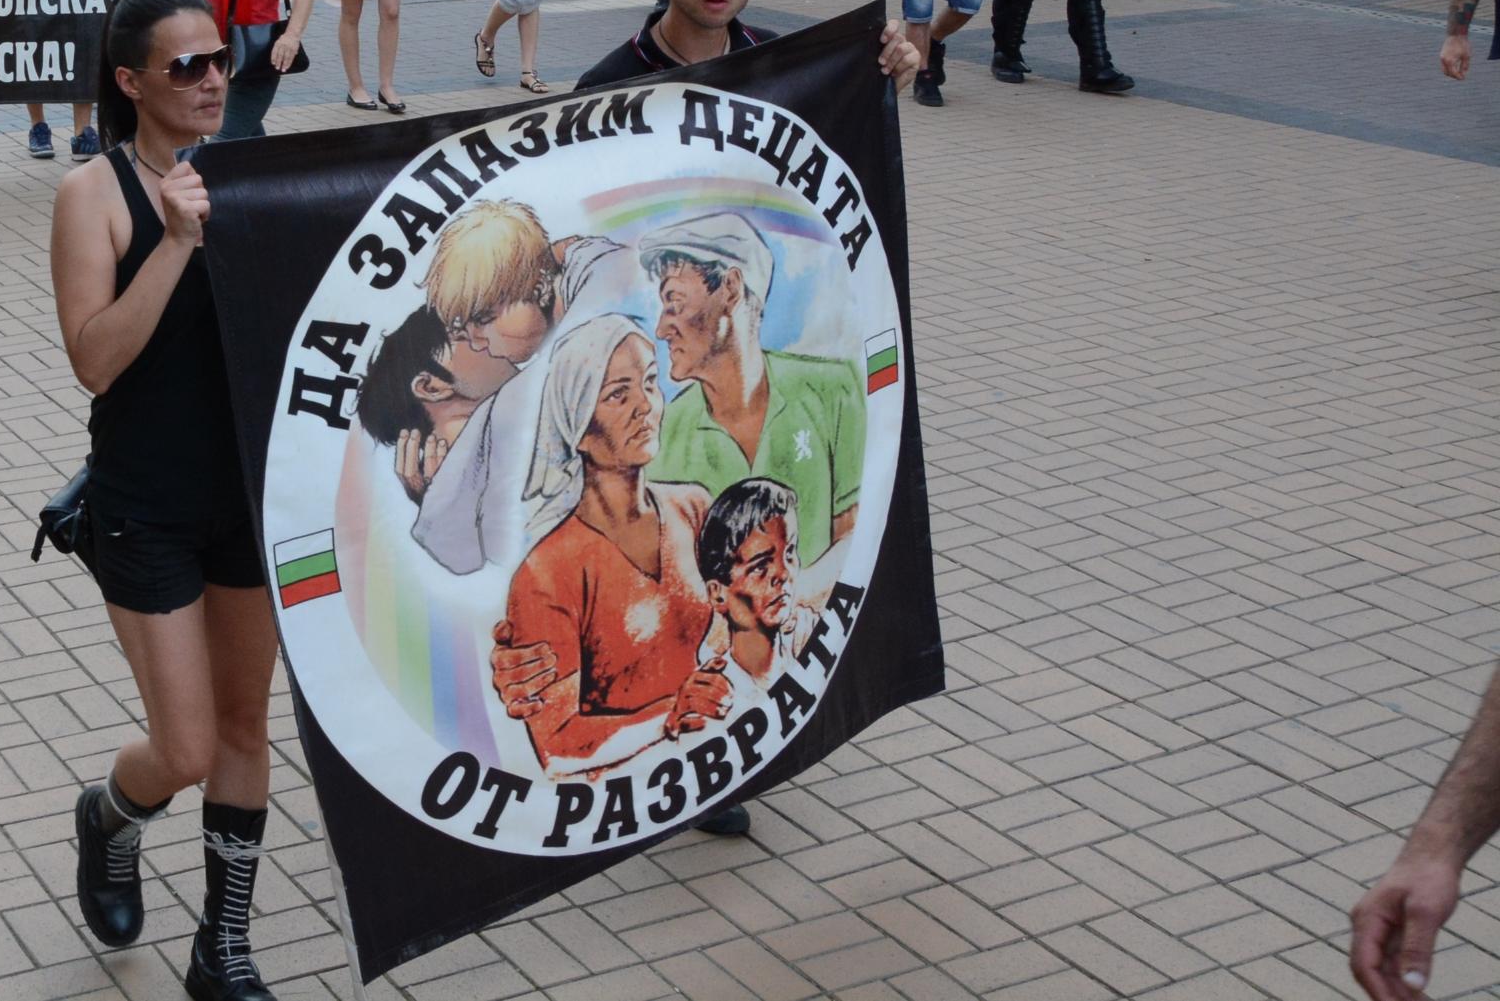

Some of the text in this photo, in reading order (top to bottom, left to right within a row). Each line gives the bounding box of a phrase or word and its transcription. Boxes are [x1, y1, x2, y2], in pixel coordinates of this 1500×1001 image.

[286, 88, 870, 430] ДА ЗАПАЗИМ ДЕЦАТА
[420, 580, 867, 848] ОТ РАЗВРАТА
